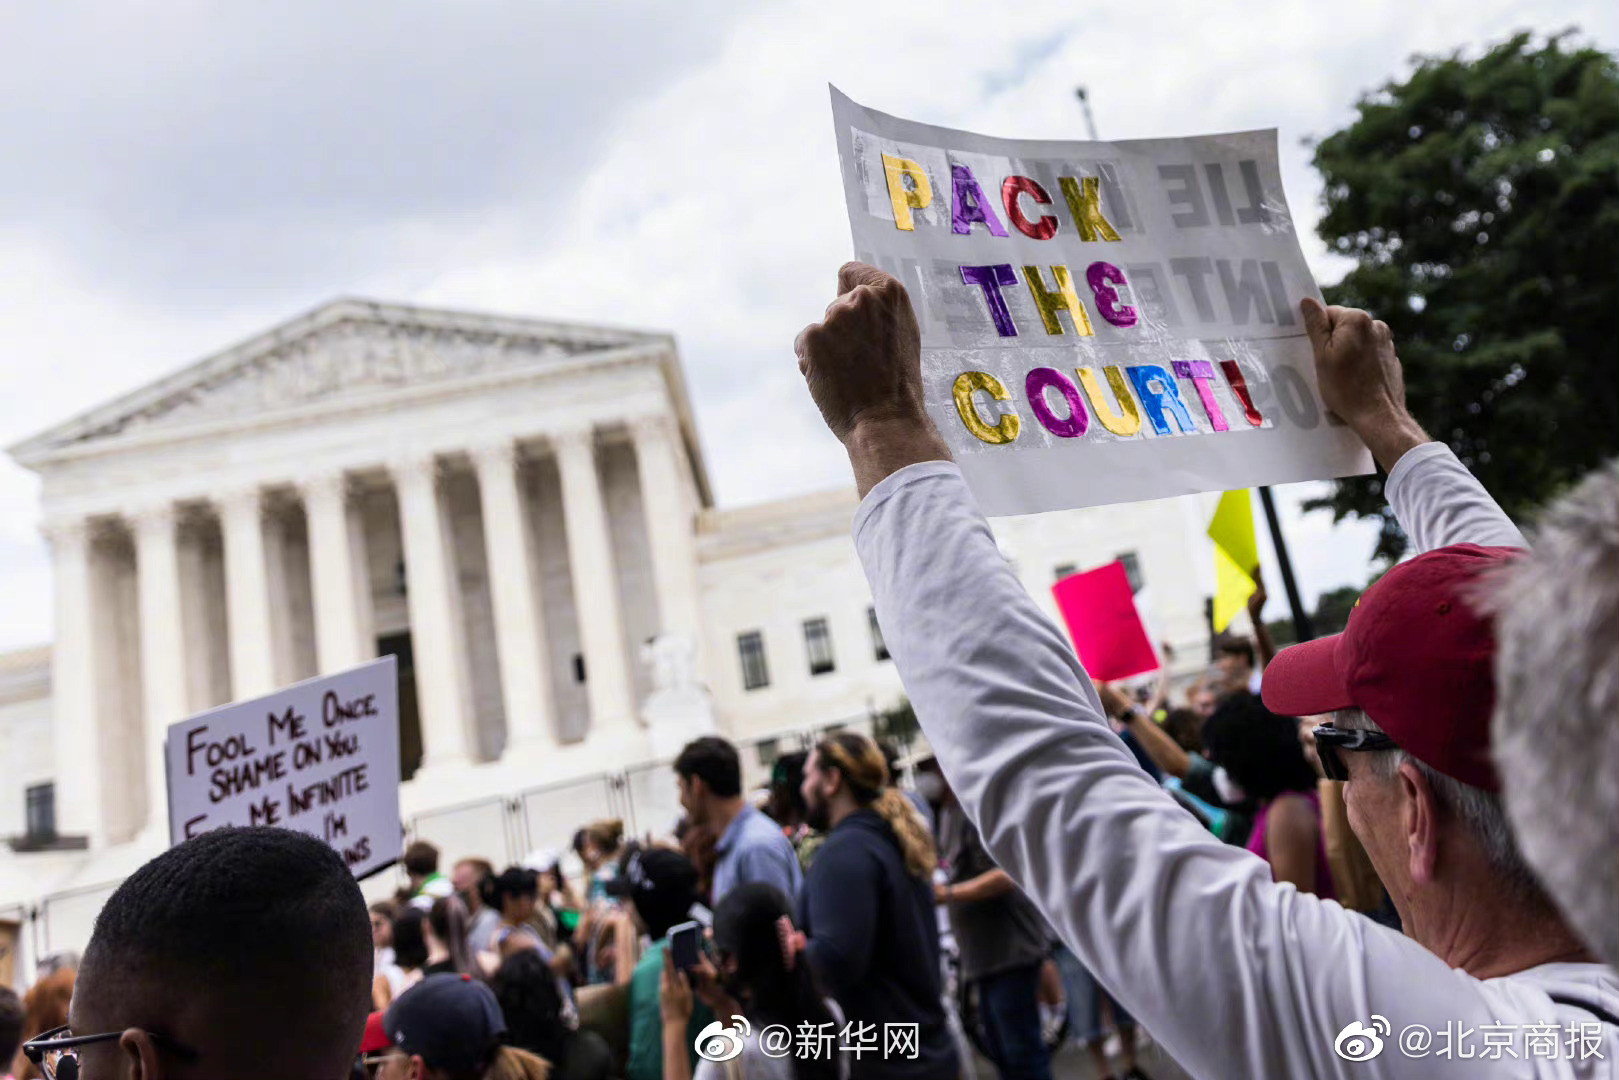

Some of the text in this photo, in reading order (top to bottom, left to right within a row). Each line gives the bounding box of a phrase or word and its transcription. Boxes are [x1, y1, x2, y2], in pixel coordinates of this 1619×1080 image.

[881, 153, 1123, 242] PACK
[959, 261, 1139, 337] THE
[952, 359, 1263, 445] COURT!
[186, 725, 256, 776] FOOL
[267, 705, 307, 746] ME
[208, 750, 288, 804] SHAME
[293, 736, 322, 771] ON
[249, 796, 281, 827] ME
[287, 763, 370, 816] INFINITE
